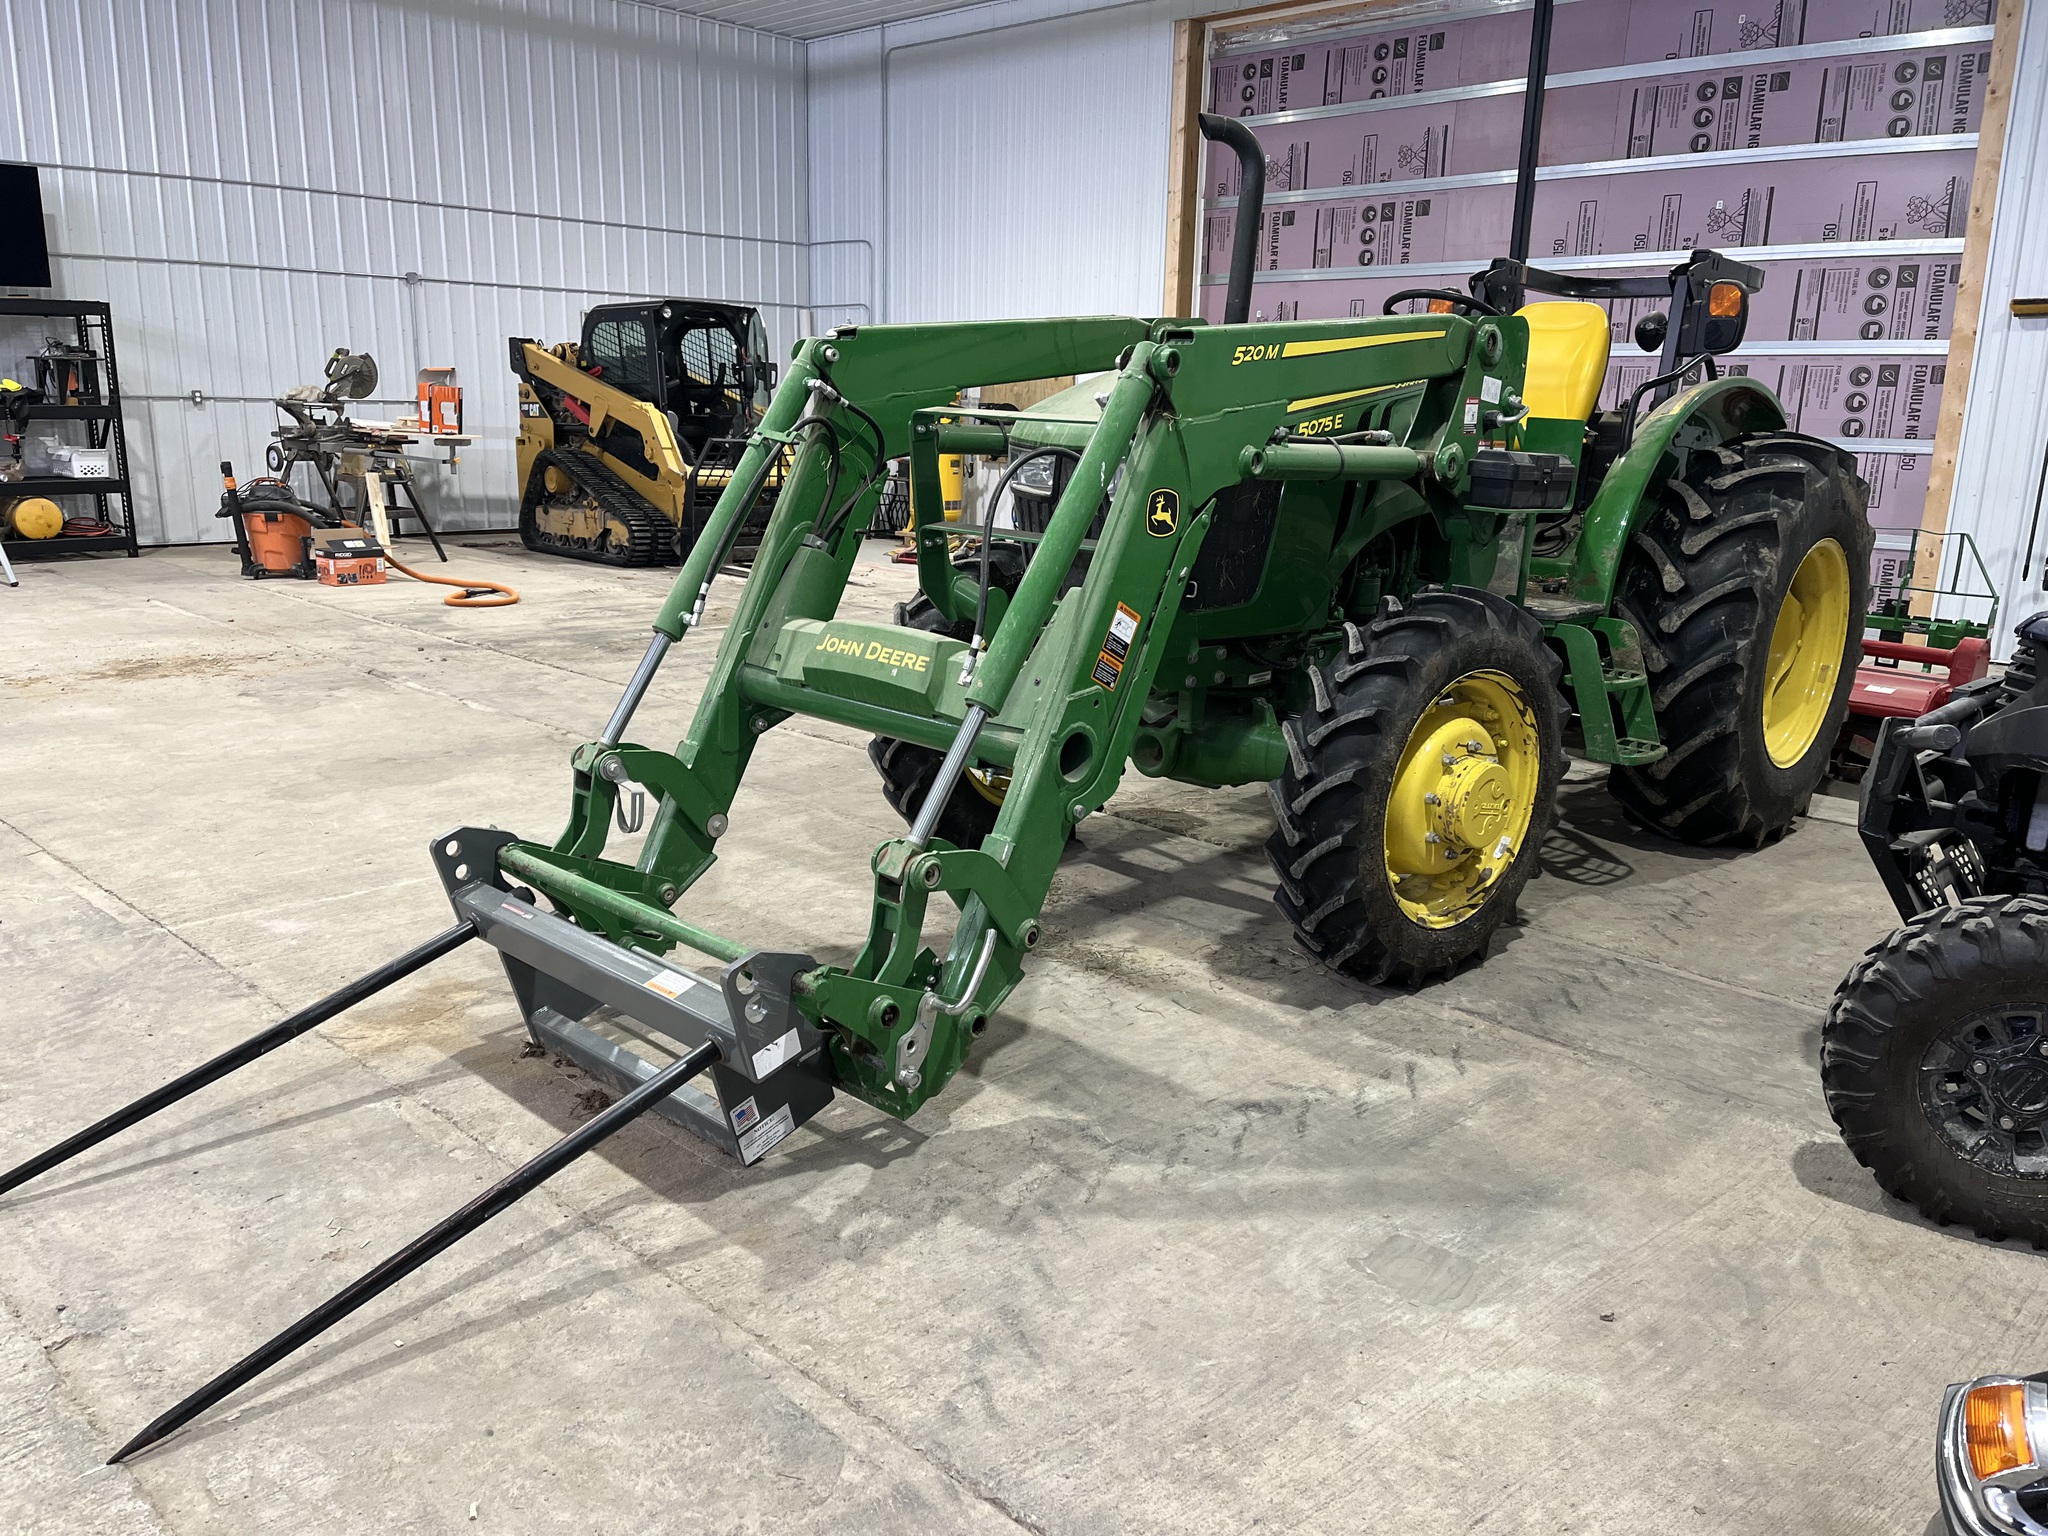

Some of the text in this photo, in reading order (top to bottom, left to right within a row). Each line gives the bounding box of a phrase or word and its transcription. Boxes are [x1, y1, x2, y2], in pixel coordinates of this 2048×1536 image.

[1414, 34, 1428, 86] FOAMULAR
[1278, 55, 1291, 104] FOAMULAR
[1955, 52, 1975, 115] FOAMULAR
[1750, 73, 1768, 131] FOAMULAR
[1342, 170, 1352, 186] 150
[1269, 212, 1282, 256] FOAMULAR
[1401, 201, 1415, 249] FOAMULAR
[1634, 234, 1646, 251] 150
[1822, 223, 1837, 242] 150
[1552, 239, 1565, 255] 150
[1927, 264, 1947, 322] FOAMULAR
[1232, 344, 1280, 366] 520 M
[530, 404, 539, 416] CAT
[1907, 365, 1928, 421] FOAMULAR
[1298, 413, 1344, 437] 5075 E
[1901, 454, 1916, 470] 150
[816, 634, 930, 672] JOHN DEERE
